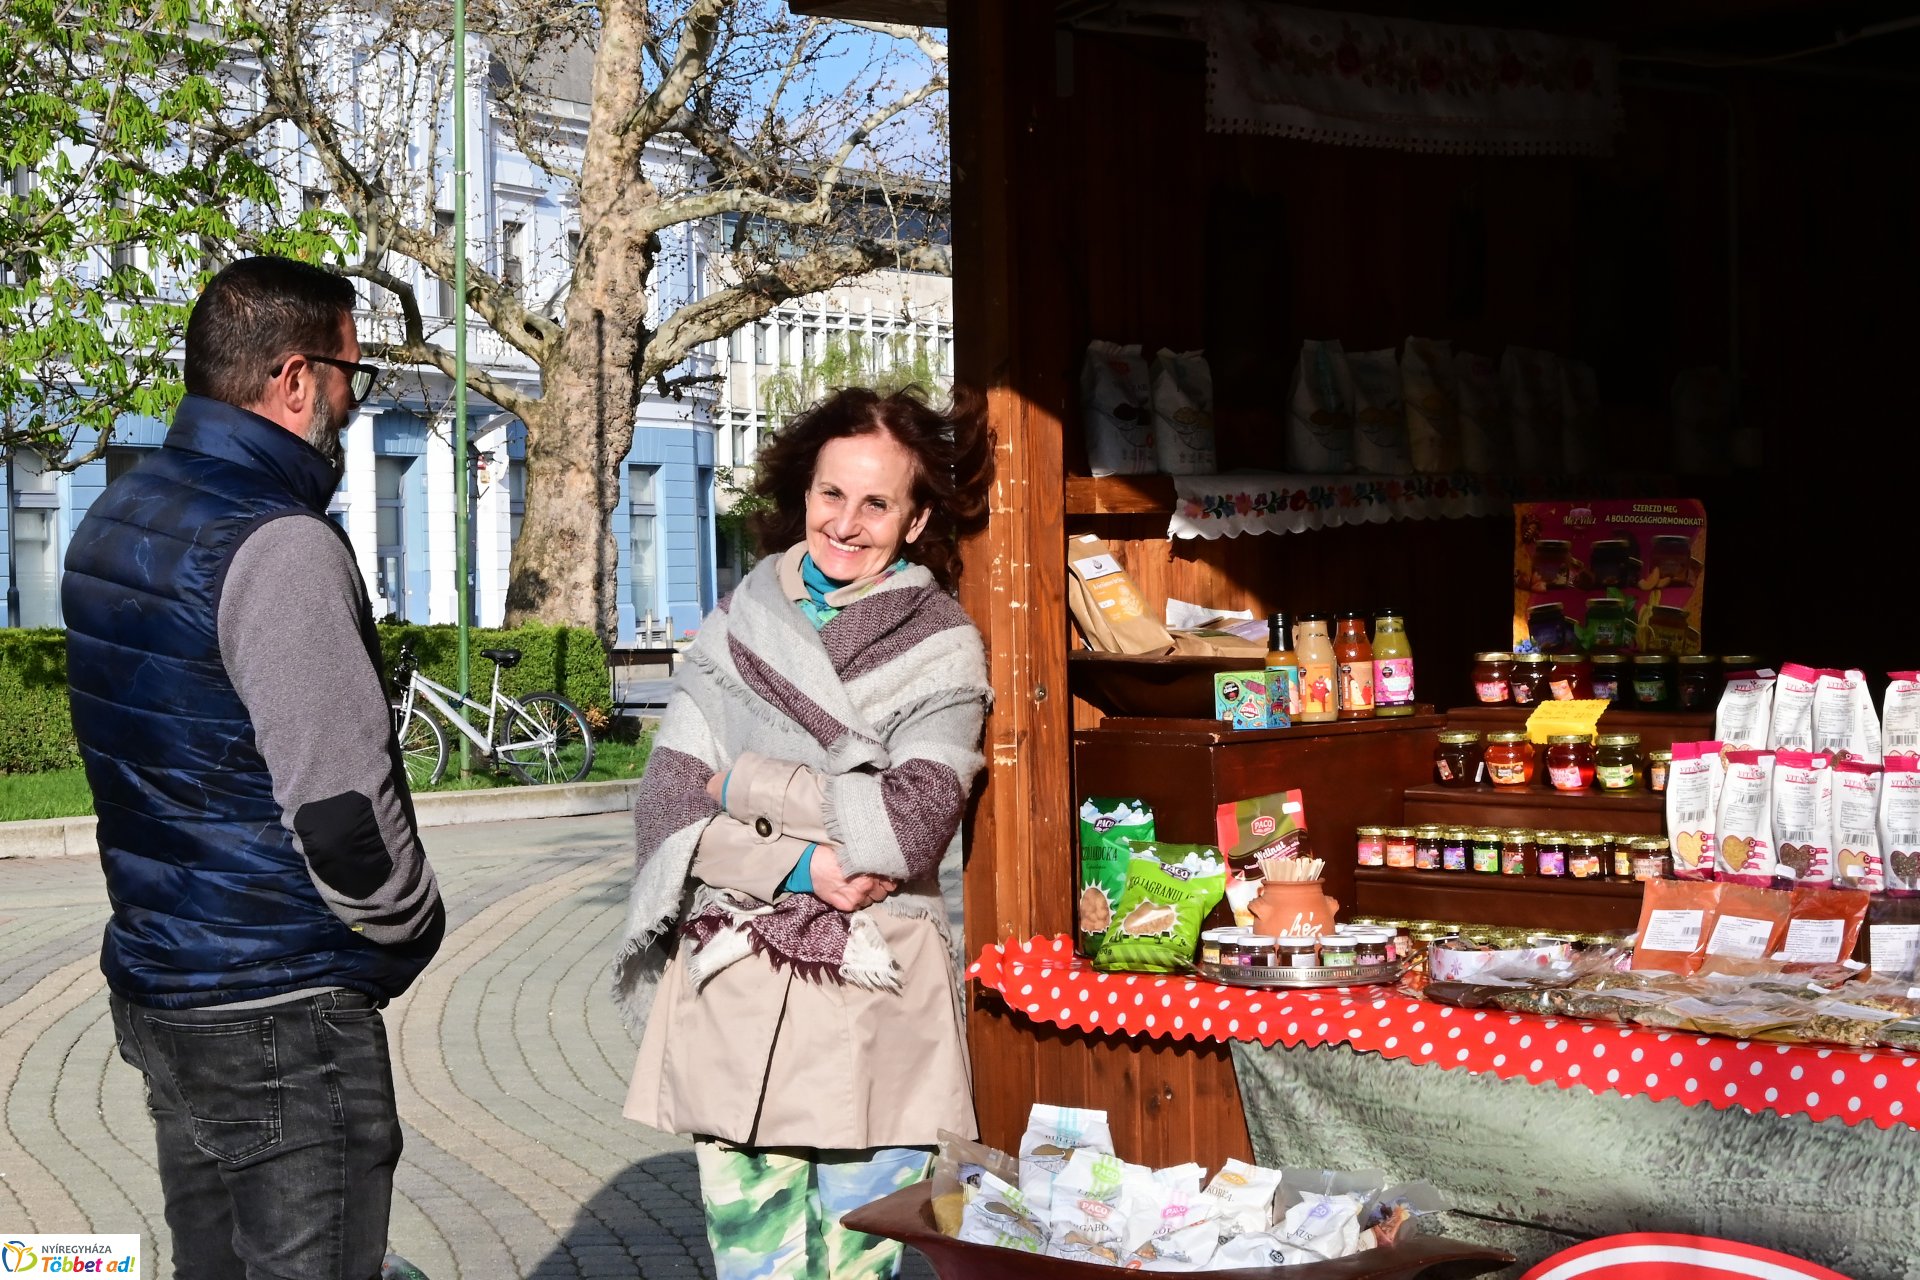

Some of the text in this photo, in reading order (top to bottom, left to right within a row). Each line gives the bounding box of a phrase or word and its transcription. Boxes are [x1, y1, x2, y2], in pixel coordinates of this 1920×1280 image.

[1632, 504, 1677, 514] SZEREZD MEG
[1605, 515, 1610, 523] A
[1096, 819, 1116, 829] PACO
[1254, 819, 1273, 830] PACO
[1253, 841, 1286, 861] Wellnut
[1163, 862, 1190, 880] PACO
[1081, 1202, 1109, 1216] PACO
